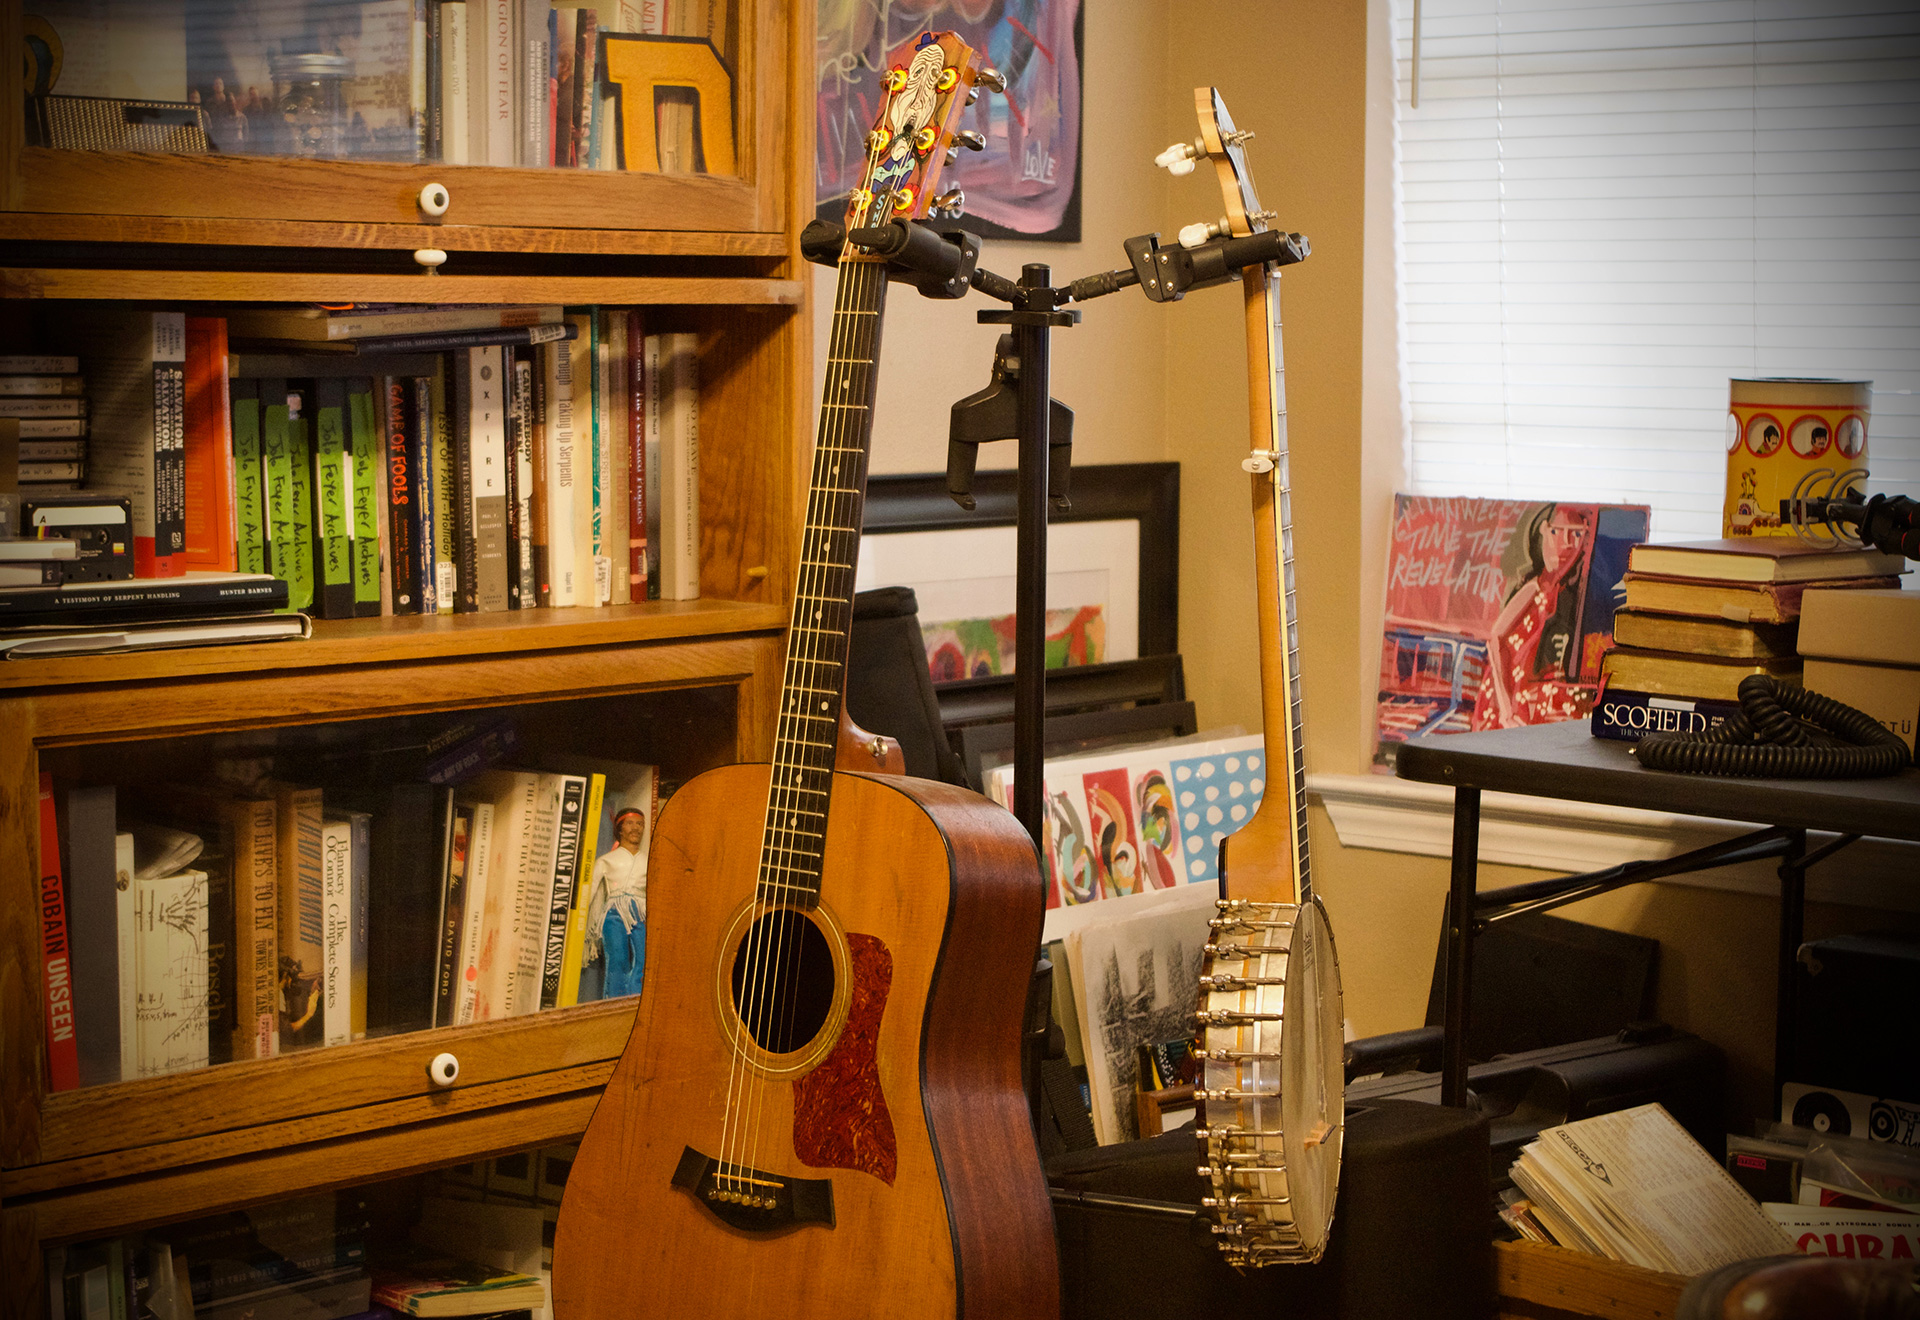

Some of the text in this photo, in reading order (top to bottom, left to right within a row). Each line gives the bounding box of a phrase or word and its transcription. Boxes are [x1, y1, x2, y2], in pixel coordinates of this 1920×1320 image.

[499, 53, 509, 74] OF
[530, 40, 536, 51] ON
[452, 77, 460, 96] DVD
[499, 81, 509, 120] FEAR
[1024, 140, 1056, 180] LOVE
[155, 369, 162, 380] ON
[162, 371, 170, 450] SALVATION
[174, 371, 184, 449] SALVATION
[522, 369, 532, 465] CAN SOMEBODY
[556, 340, 574, 487] imbrough Taking Up Serpents
[636, 392, 644, 411] The
[690, 399, 698, 420] NO
[389, 384, 409, 505] GAME OF FOOLS
[462, 441, 469, 457] OF
[322, 464, 338, 506] Feyer
[438, 411, 451, 556] TESTS OF FAITH Holliday
[462, 460, 470, 482] THE
[601, 450, 609, 492] SERPENTS
[39, 515, 47, 524] A
[354, 486, 371, 529] Feyer
[463, 484, 471, 533] SERPENT
[634, 477, 644, 525] Prophets
[274, 520, 291, 578] Archives
[326, 513, 343, 572] Archives
[520, 500, 530, 570] PATSY SIMS
[616, 467, 628, 591] PROPHETS Barnes
[1404, 521, 1517, 558] TIME THE
[358, 536, 376, 586] Archives
[464, 535, 473, 591] HANDLER
[1390, 554, 1505, 604] REVELATOR
[62, 596, 101, 604] TESTIMONY
[147, 592, 181, 600] HANDLING
[220, 587, 273, 596] HUNTER BARNES
[1603, 702, 1707, 735] SCOFIELD
[593, 785, 602, 811] MORGEN
[480, 809, 490, 841] FLANNERY
[255, 809, 274, 931] TO LIVE'S TO FLY
[477, 845, 486, 876] O'CONNOR
[552, 822, 578, 911] TAKING PUNK
[583, 864, 592, 883] COBAIN
[584, 850, 594, 863] KURT
[298, 872, 322, 947] HAMMER
[335, 840, 348, 941] Flannery The
[504, 782, 535, 1010] THE LINE THAT HELD US DAVID
[326, 835, 339, 1009] O'Connor Complete Stories
[470, 925, 478, 952] VIOLENT
[41, 875, 73, 1043] COBAIN UNSEEN
[256, 939, 267, 970] TOWNES
[441, 920, 456, 997] DAVID FORD
[545, 924, 565, 976] MASSES
[209, 939, 227, 1022] Bosch
[256, 974, 267, 991] VAN
[1556, 1129, 1597, 1168] DECCA
